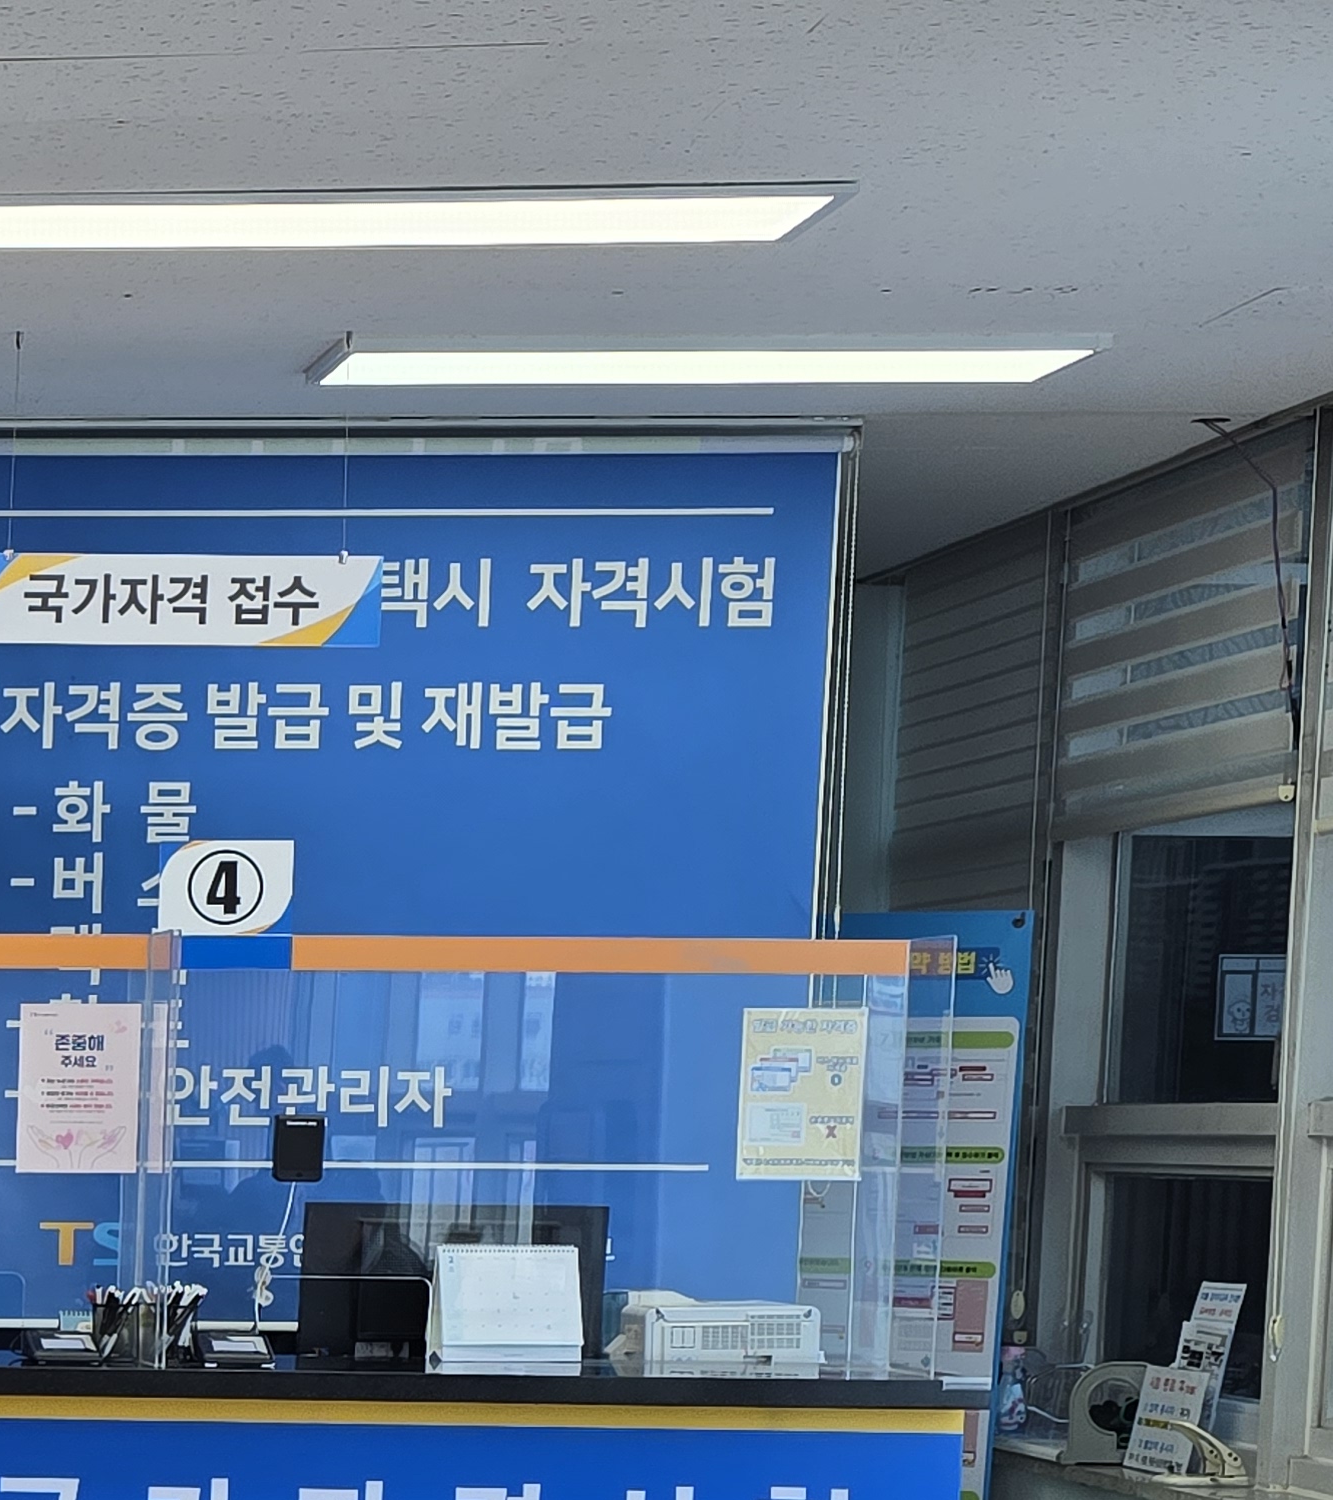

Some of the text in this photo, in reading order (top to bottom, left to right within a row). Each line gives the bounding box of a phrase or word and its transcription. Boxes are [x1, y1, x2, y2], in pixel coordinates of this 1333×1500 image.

[23, 573, 320, 627] 국가자격 접수
[527, 556, 776, 628] 자격시험
[1, 681, 612, 751] 자격증 발급 및 재발급
[910, 951, 931, 974] 약
[54, 1034, 105, 1051] 존중해
[60, 1055, 98, 1068] 주세요
[167, 1065, 452, 1128] 안전관리자
[153, 1233, 305, 1268] 한국교통
